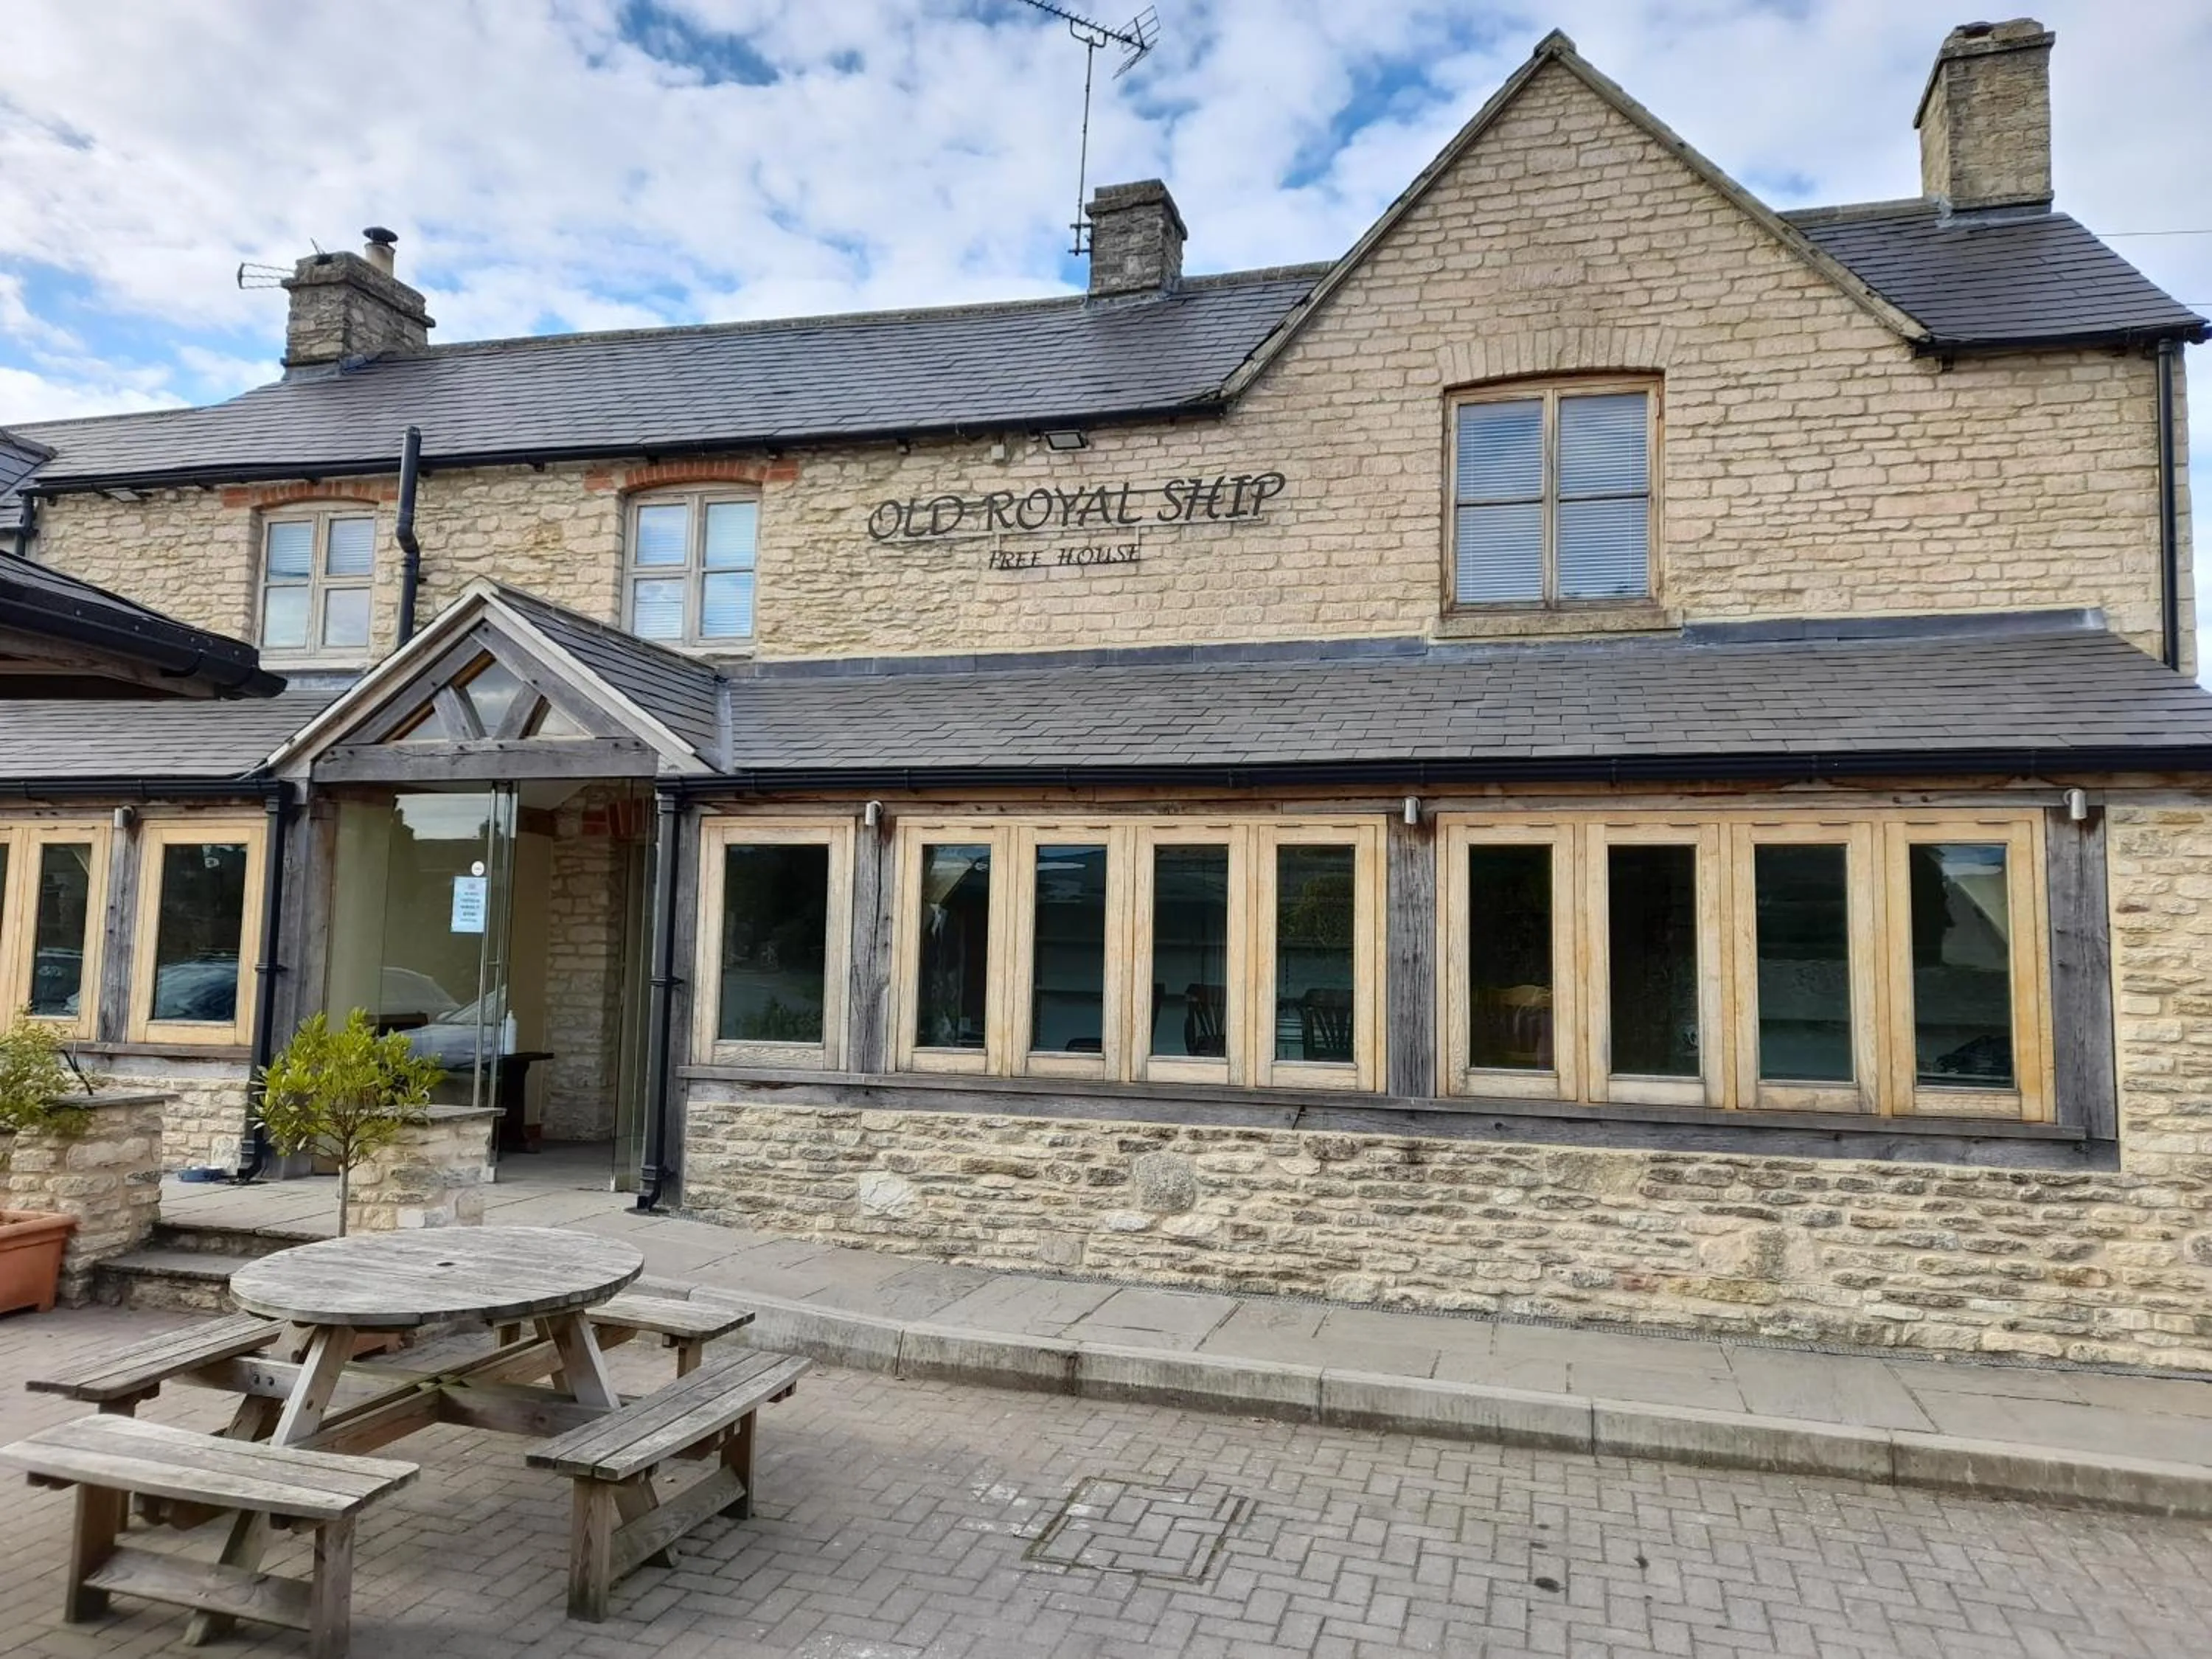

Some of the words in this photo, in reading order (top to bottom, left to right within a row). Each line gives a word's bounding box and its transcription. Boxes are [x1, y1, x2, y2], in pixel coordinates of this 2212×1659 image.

[868, 495, 964, 540] OLD
[985, 482, 1142, 532] ROYAL
[1157, 472, 1287, 521] SHIP
[988, 549, 1041, 569] FREE
[1057, 545, 1141, 567] HOUSE
